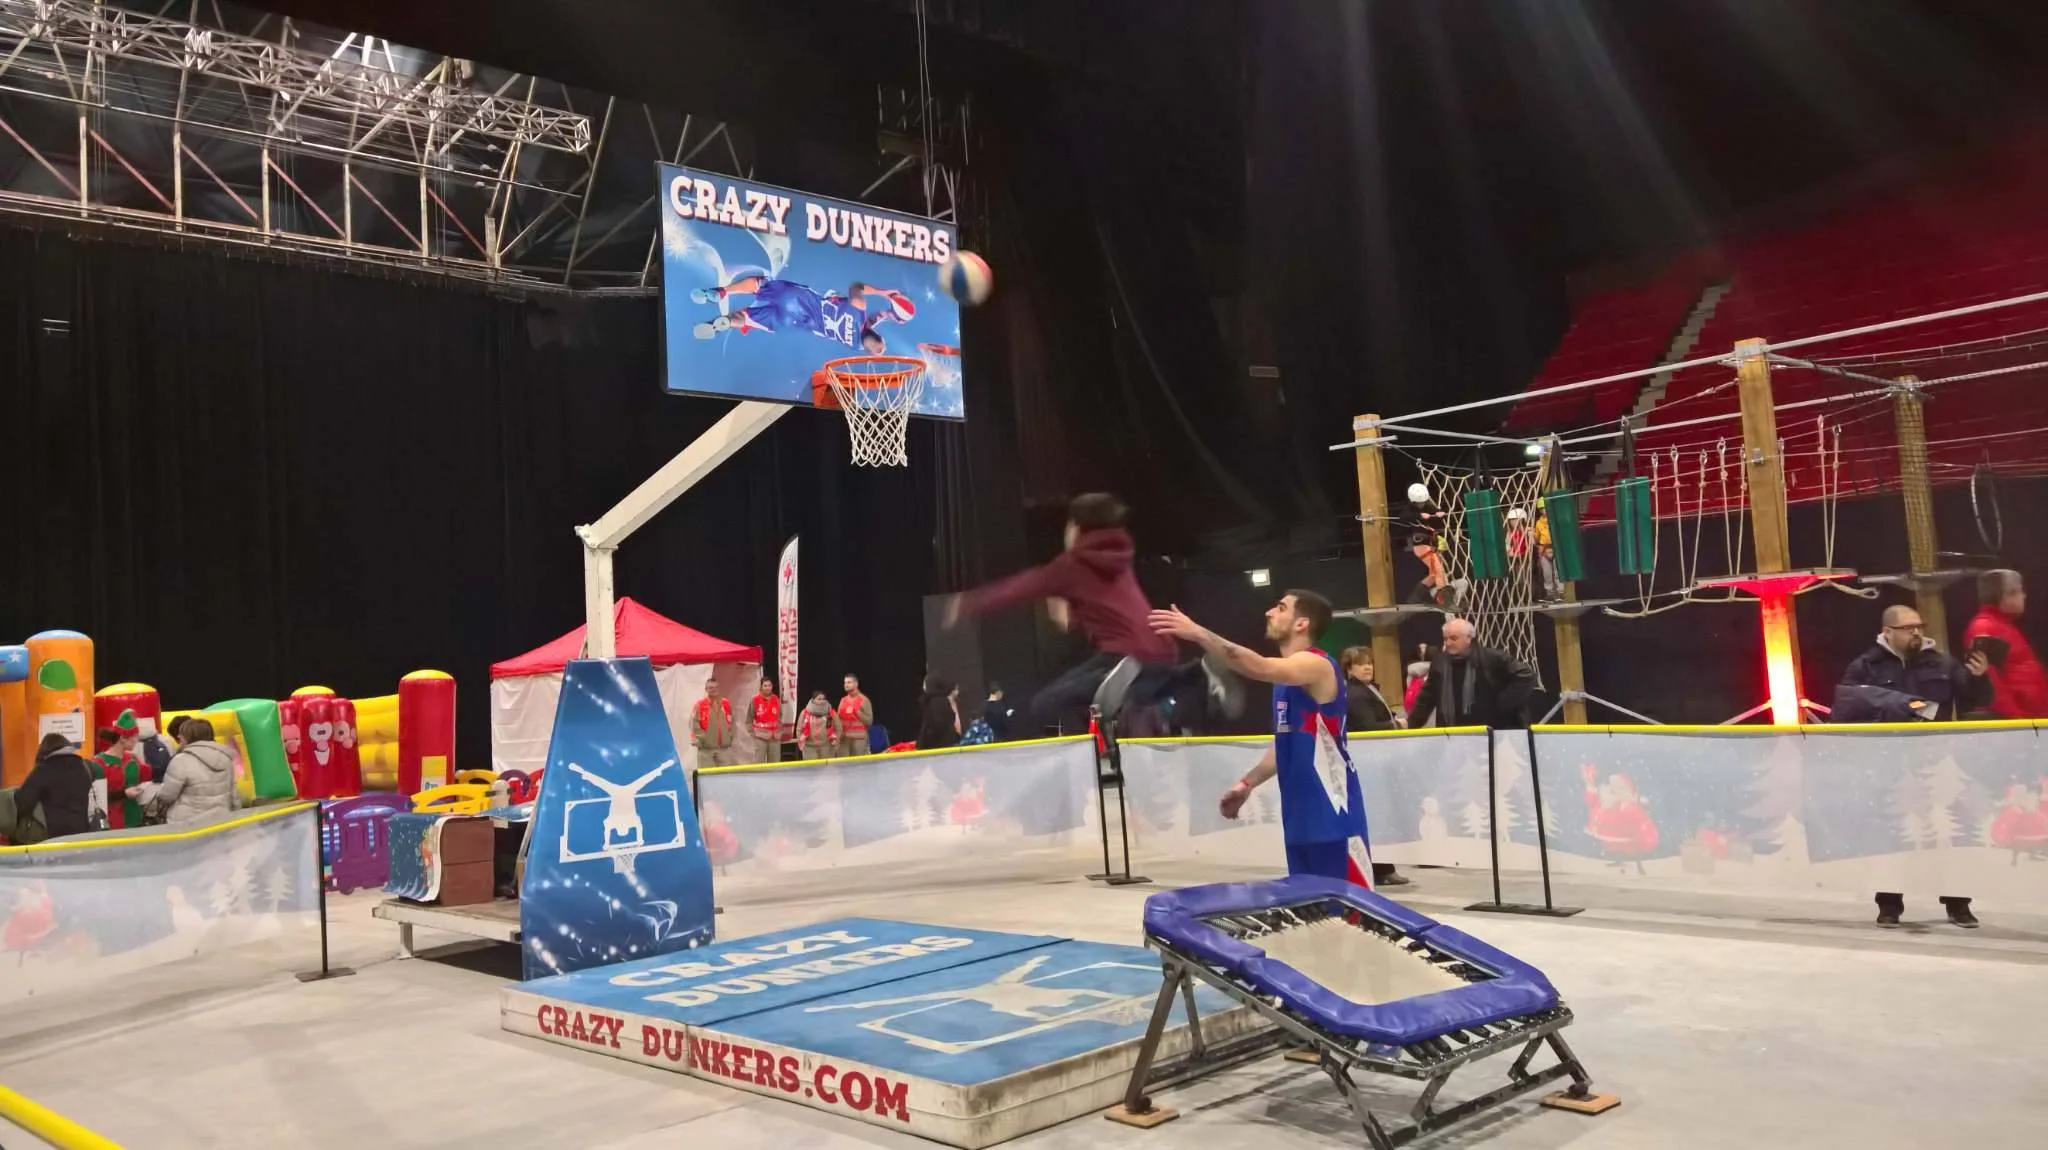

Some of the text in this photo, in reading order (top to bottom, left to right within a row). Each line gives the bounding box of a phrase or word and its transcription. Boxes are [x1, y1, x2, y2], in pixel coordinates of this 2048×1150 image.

[671, 176, 951, 264] CRAZY DUNKERS
[608, 930, 873, 986] CRAZY
[642, 935, 974, 1007] DUNKERS
[537, 1004, 911, 1123] CRAZY DUNKERS.COM
